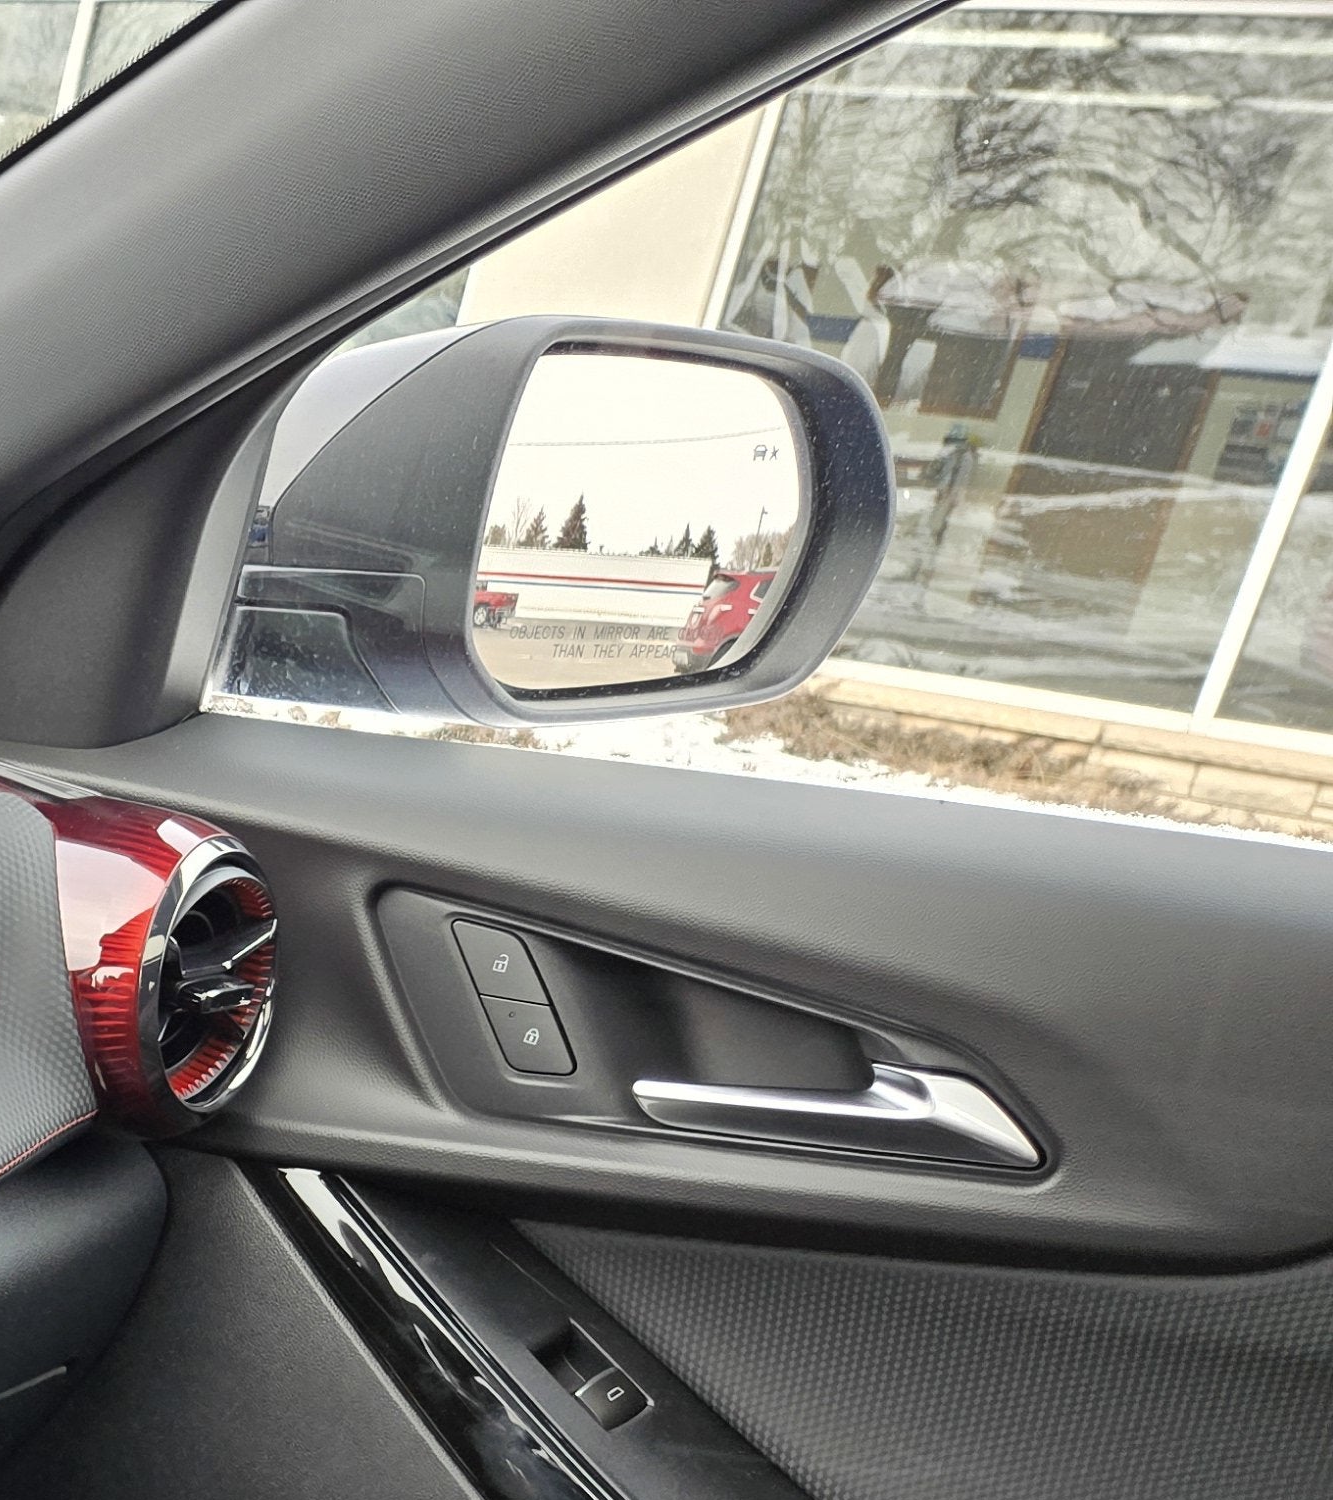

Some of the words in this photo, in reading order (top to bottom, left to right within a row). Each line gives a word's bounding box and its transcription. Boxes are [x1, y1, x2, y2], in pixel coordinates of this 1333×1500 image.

[509, 626, 565, 640] OBJECTS
[573, 626, 587, 639] IN
[594, 626, 640, 639] MIRROR
[647, 627, 670, 640] ARE
[552, 644, 583, 658] THAN
[593, 645, 622, 658] THEY
[629, 645, 677, 659] APPEAR
